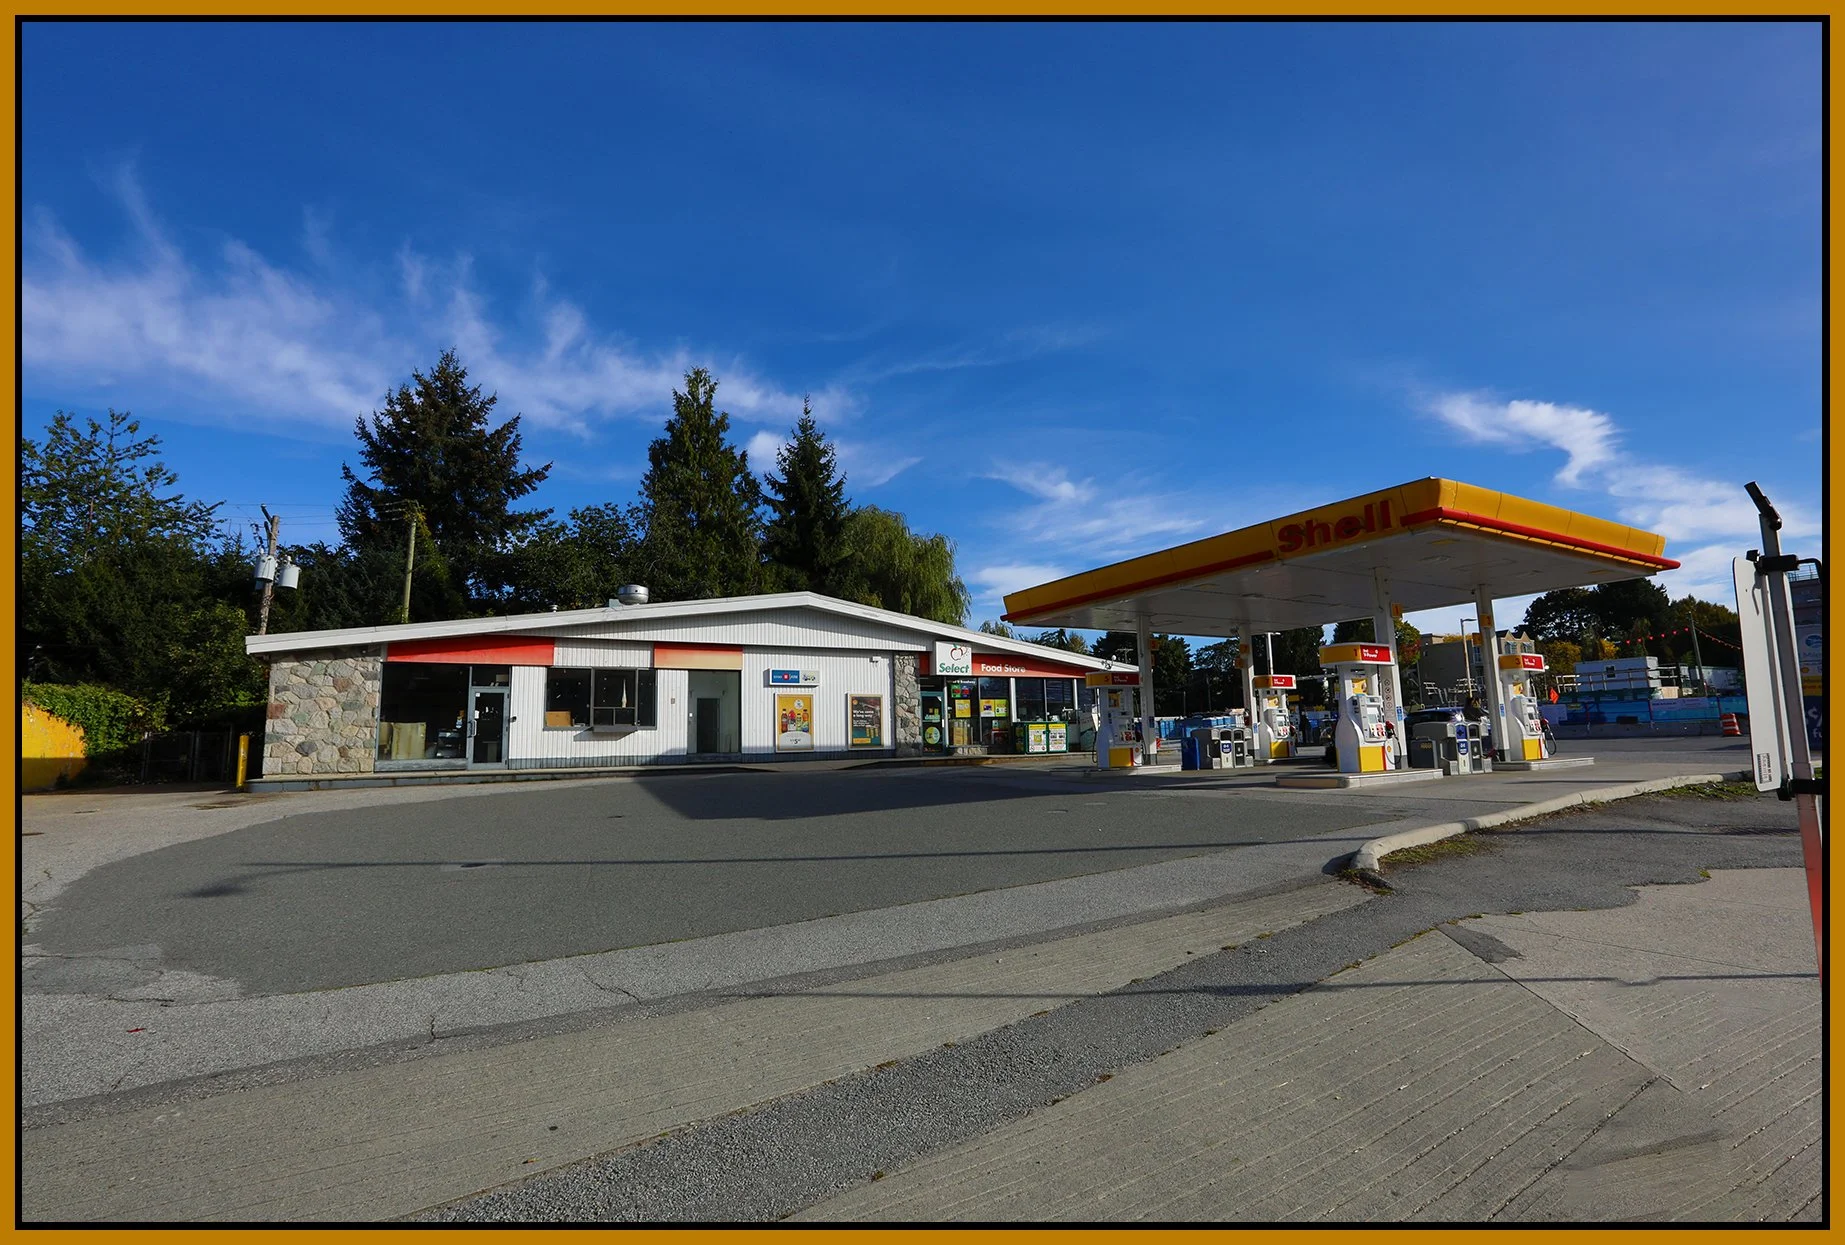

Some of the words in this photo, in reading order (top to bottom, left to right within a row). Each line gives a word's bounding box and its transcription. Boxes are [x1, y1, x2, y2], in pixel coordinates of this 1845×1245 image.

[1278, 499, 1393, 553] Shell
[938, 662, 970, 674] Select
[981, 663, 1002, 673] Food
[1004, 664, 1026, 673] Store
